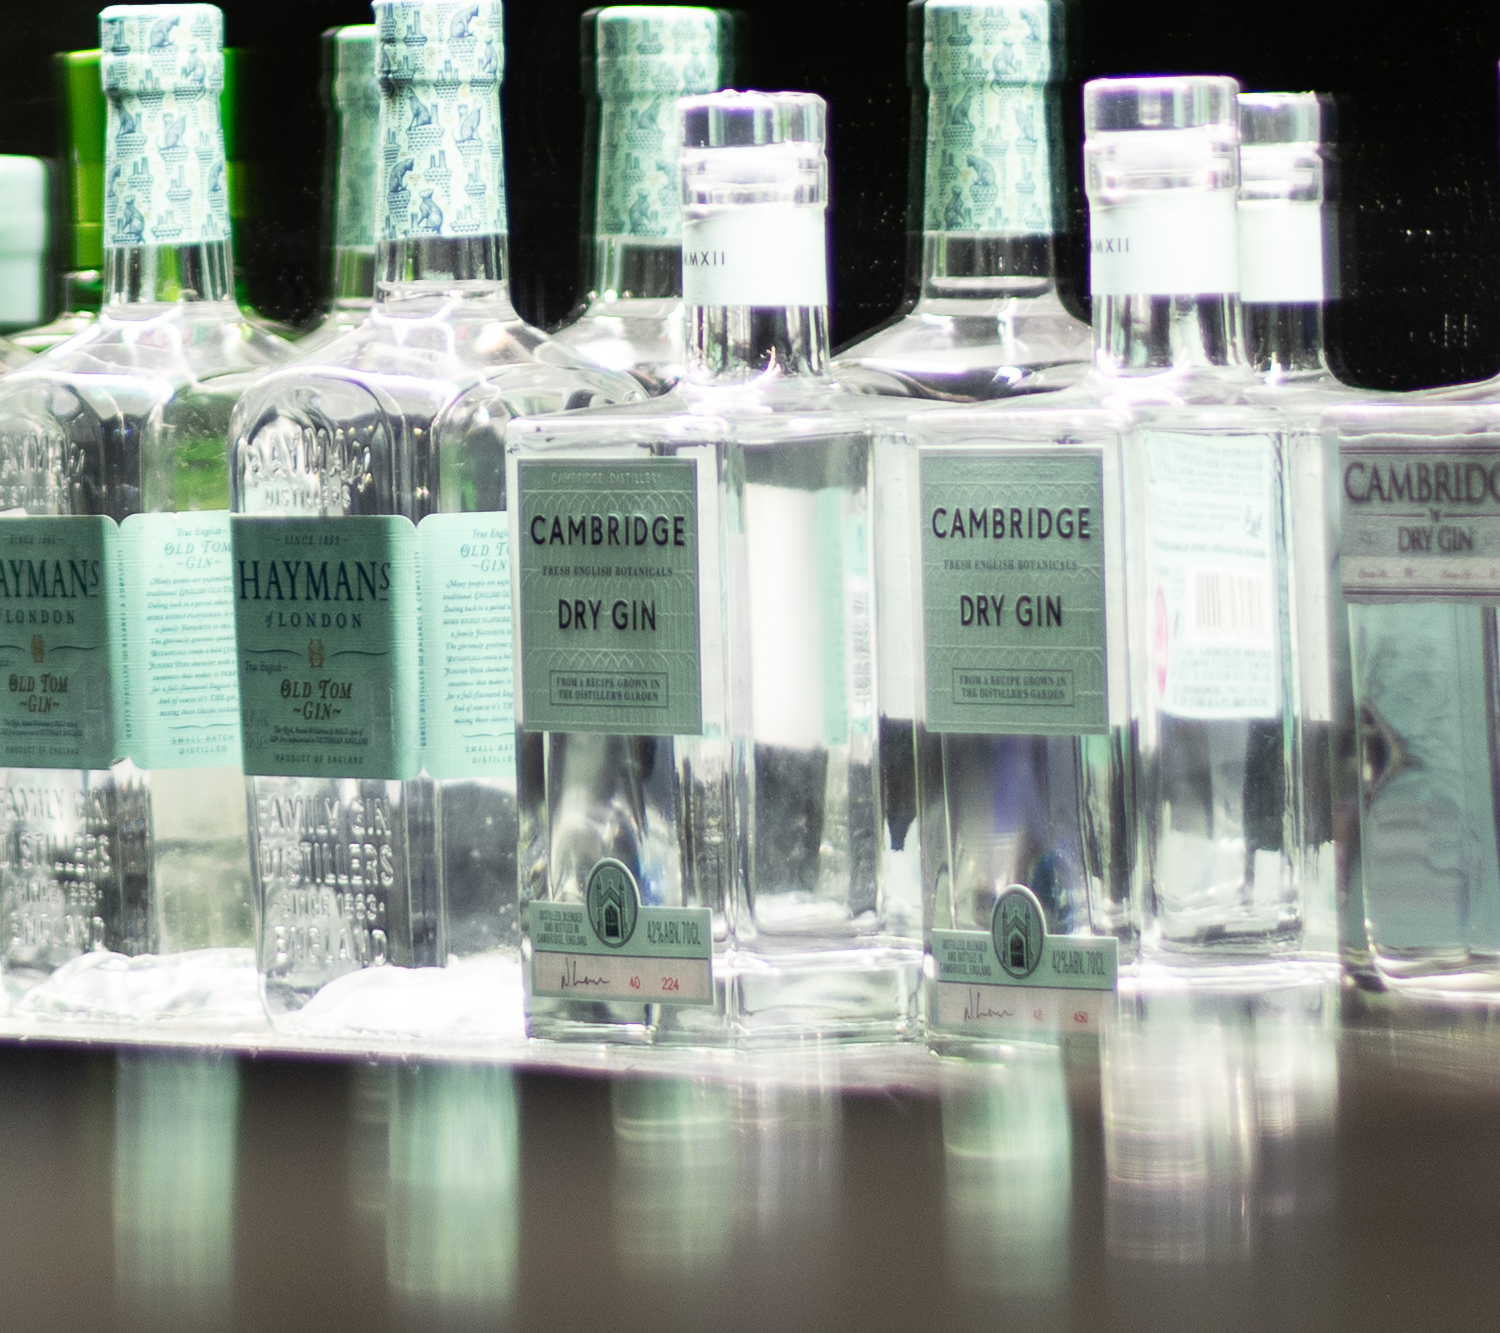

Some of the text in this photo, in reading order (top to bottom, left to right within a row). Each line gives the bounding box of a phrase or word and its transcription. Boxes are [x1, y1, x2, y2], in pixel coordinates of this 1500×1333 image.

[530, 513, 686, 547] CAMBRIDGE
[932, 506, 1092, 540] CAMBRIDGE
[1397, 525, 1474, 553] DRY GIN
[615, 565, 674, 578] BOTANICALS
[1018, 558, 1079, 572] BOTANICALS
[239, 559, 392, 602] HAYMANS
[5, 609, 76, 625] LONDON
[277, 611, 363, 629] LONDON
[558, 598, 657, 631] DRY GIN
[960, 593, 1063, 628] DRY GIN
[40, 672, 69, 693] TOM
[280, 677, 354, 700] OLD TOM
[260, 840, 395, 886] DISTILLERS
